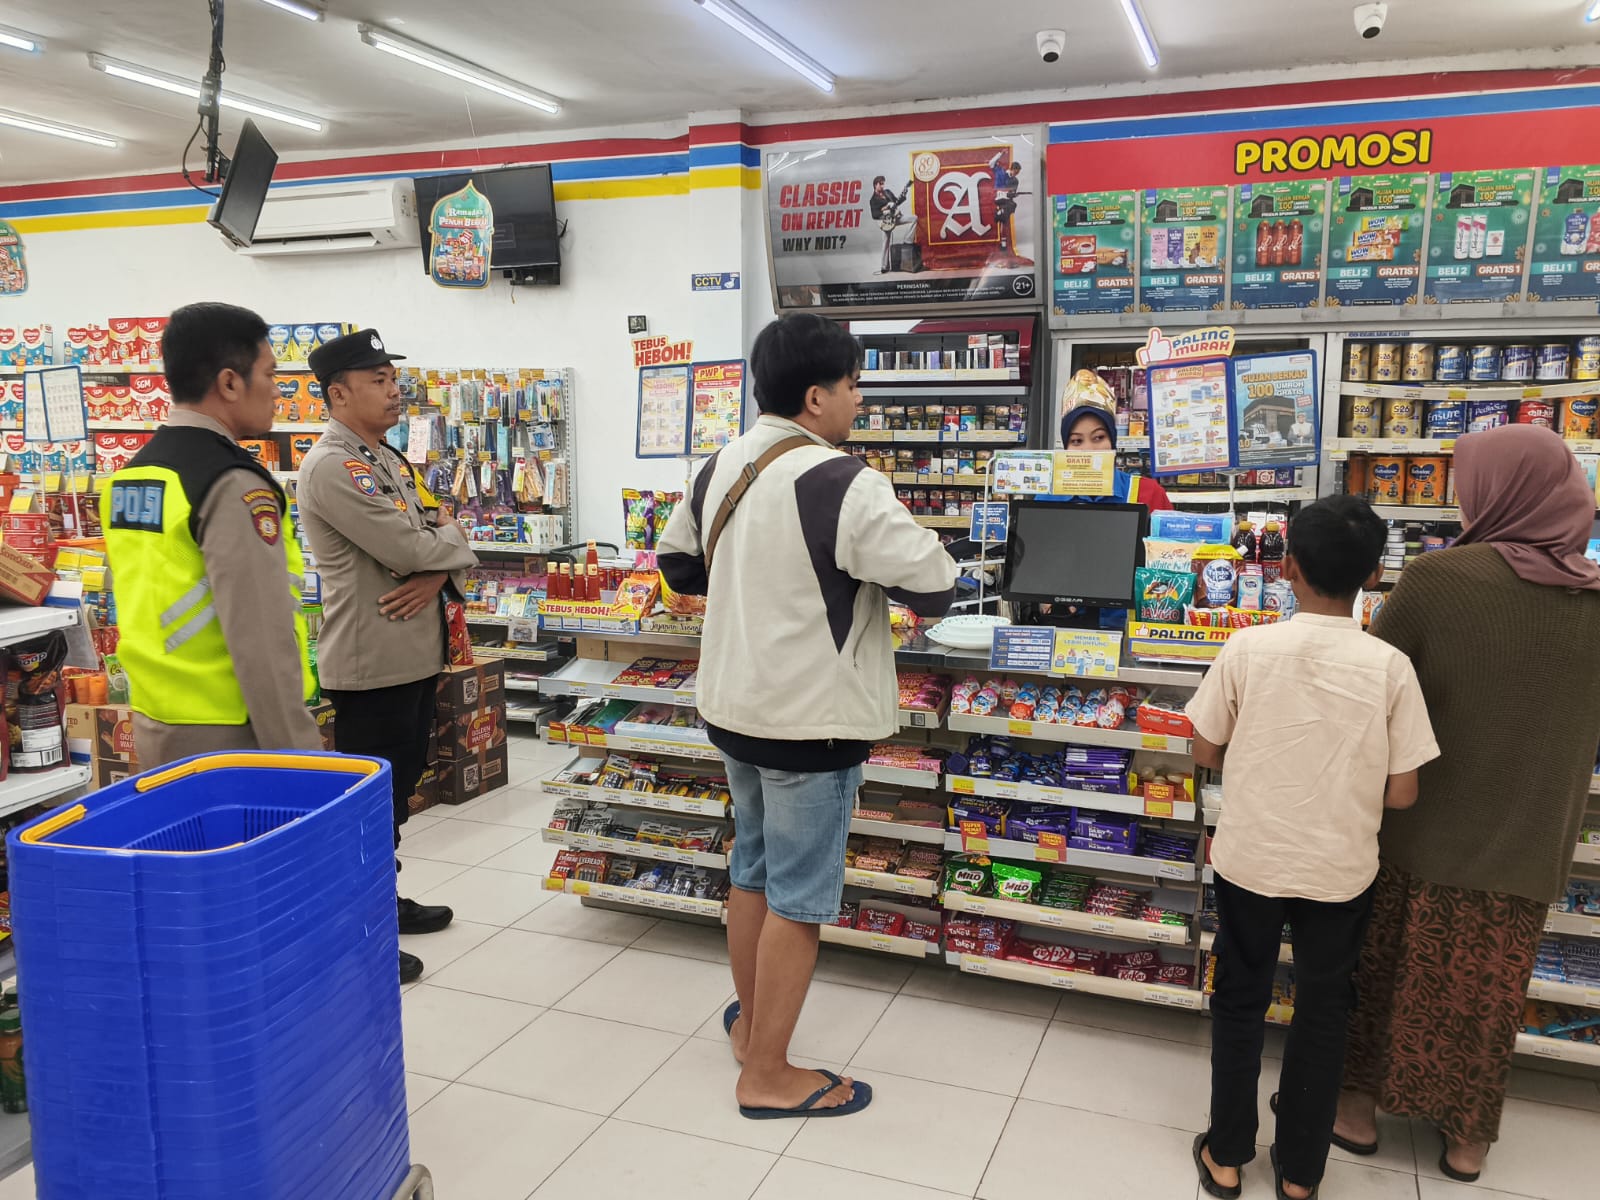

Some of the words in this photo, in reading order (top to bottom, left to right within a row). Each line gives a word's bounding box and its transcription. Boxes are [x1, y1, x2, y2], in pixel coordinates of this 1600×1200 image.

[1235, 129, 1432, 174] PROMOSI
[779, 180, 862, 208] CLASSIC
[932, 171, 993, 240] A
[781, 212, 804, 231] ON
[806, 208, 863, 231] REPEAT
[782, 237, 812, 251] WHY
[814, 235, 847, 250] NOT?
[1340, 269, 1360, 277] BELI
[1361, 268, 1368, 276] 2
[1379, 267, 1412, 276] GRATIS
[1438, 267, 1459, 275] BELI
[1461, 266, 1467, 274] 2
[1478, 265, 1513, 274] GRATIS
[1515, 265, 1520, 273] 1
[1542, 264, 1565, 272] BELI
[1567, 263, 1572, 271] 1
[1219, 275, 1223, 283] 1
[1245, 274, 1265, 282] BELI
[1266, 273, 1272, 281] 2
[1282, 272, 1314, 280] GRATIS
[695, 277, 721, 287] CCTV
[1015, 282, 1030, 290] 21+
[1064, 281, 1082, 289] BELI
[1084, 280, 1089, 288] 2
[1098, 279, 1128, 287] GRATIS
[146, 321, 159, 329] SGM
[634, 337, 666, 350] TEBUS
[1172, 330, 1229, 348] PALING
[1175, 340, 1230, 357] MURAH
[635, 343, 692, 366] HEBOH!
[700, 367, 719, 378] PWP
[136, 379, 151, 389] SGM
[1247, 384, 1274, 399] 100
[1475, 402, 1507, 415] PediaSure
[1427, 409, 1460, 422] Ensure
[101, 436, 116, 446] SGM
[123, 437, 137, 446] SGM
[546, 604, 572, 613] TEBUS
[574, 605, 610, 617] HEBOH!
[1150, 629, 1206, 640] PALING
[471, 725, 491, 737] GOLDEN
[1148, 789, 1169, 797] HEMAT
[957, 871, 981, 880] MILO
[1004, 882, 1029, 891] MILO
